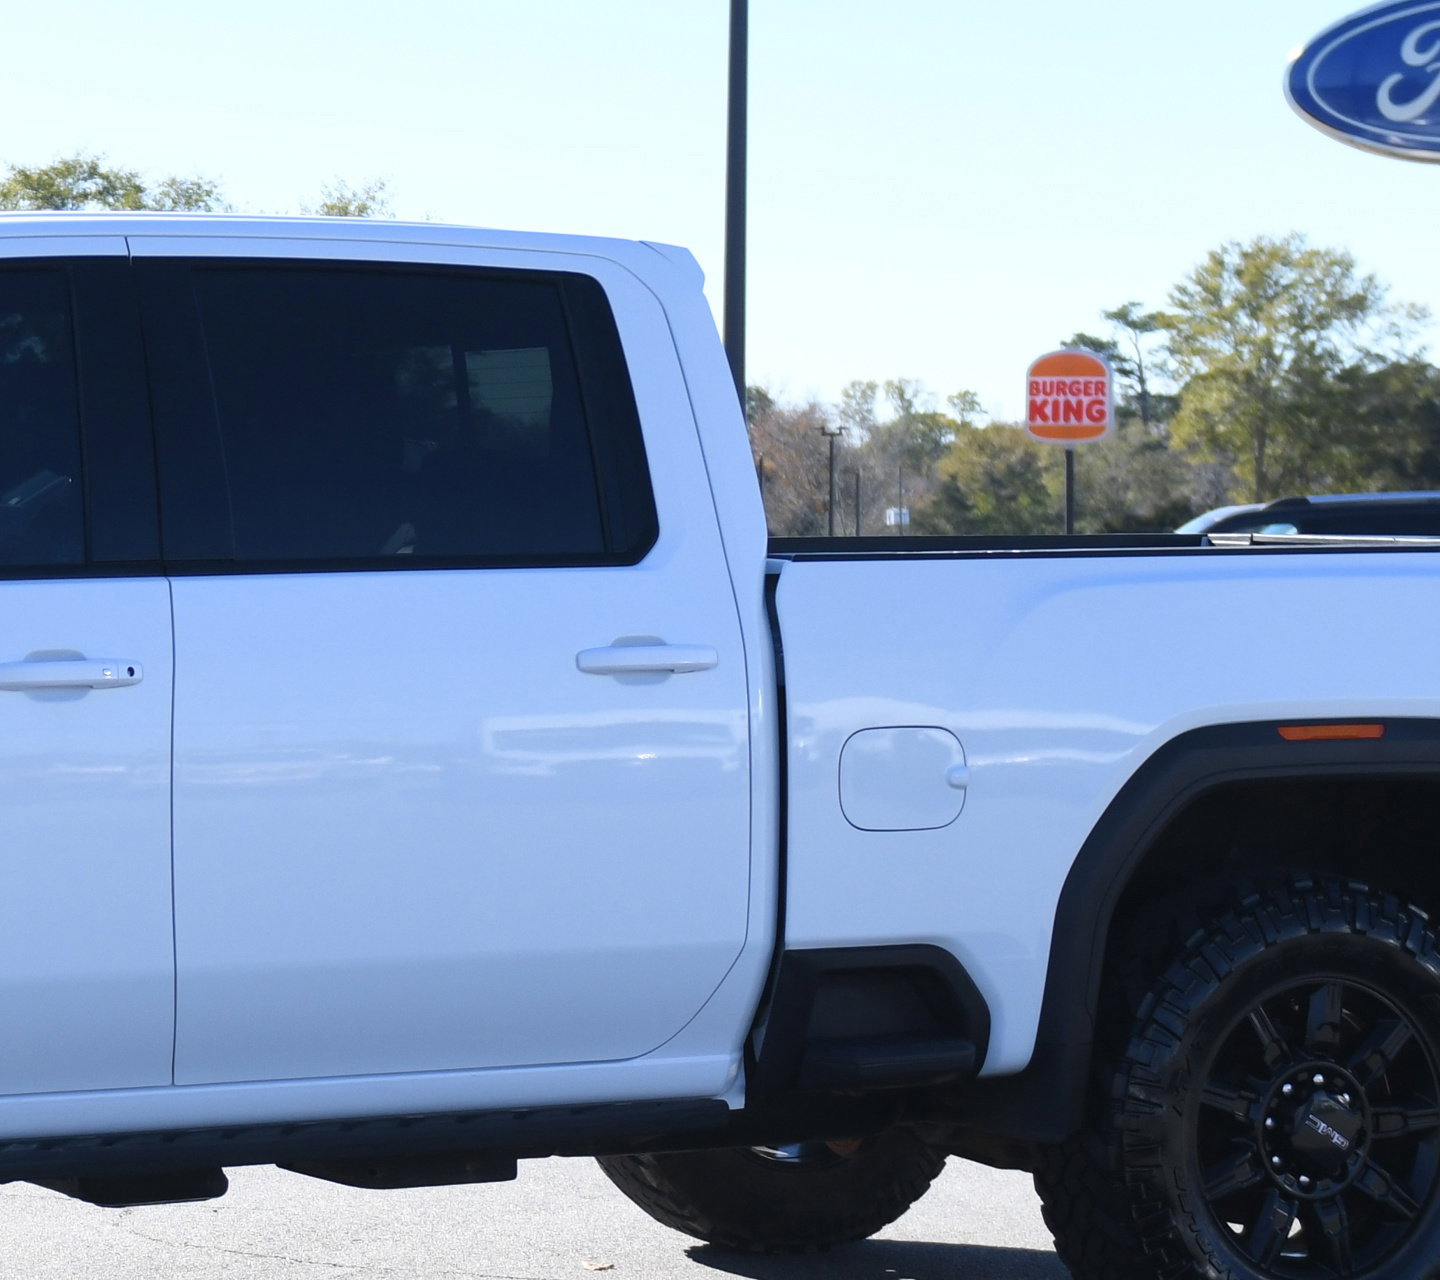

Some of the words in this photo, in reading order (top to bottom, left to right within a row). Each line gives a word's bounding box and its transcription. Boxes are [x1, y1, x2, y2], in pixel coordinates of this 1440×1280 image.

[1028, 380, 1107, 397] BURGER
[1028, 399, 1107, 424] KING
[1305, 1114, 1350, 1151] GMC
